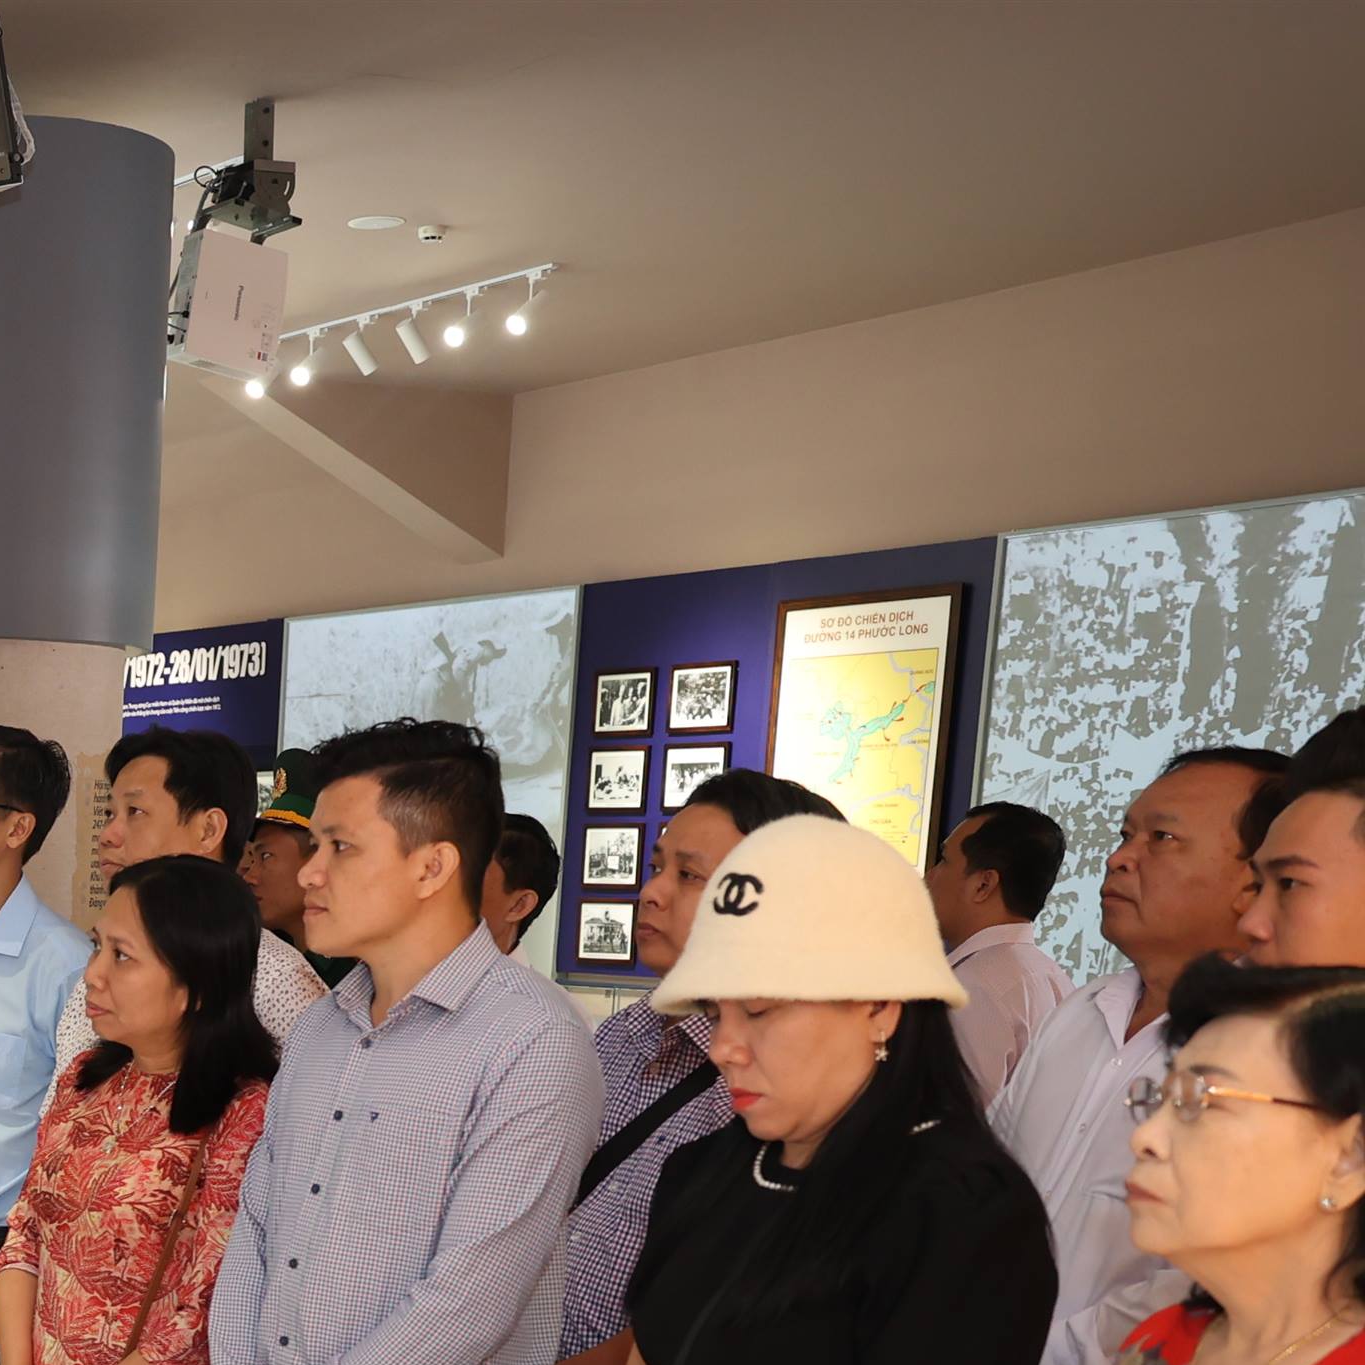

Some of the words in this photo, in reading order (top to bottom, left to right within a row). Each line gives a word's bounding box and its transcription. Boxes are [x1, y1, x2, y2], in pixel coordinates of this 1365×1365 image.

[888, 609, 914, 625] DỊCH
[846, 630, 855, 640] 14
[899, 622, 929, 636] LONG
